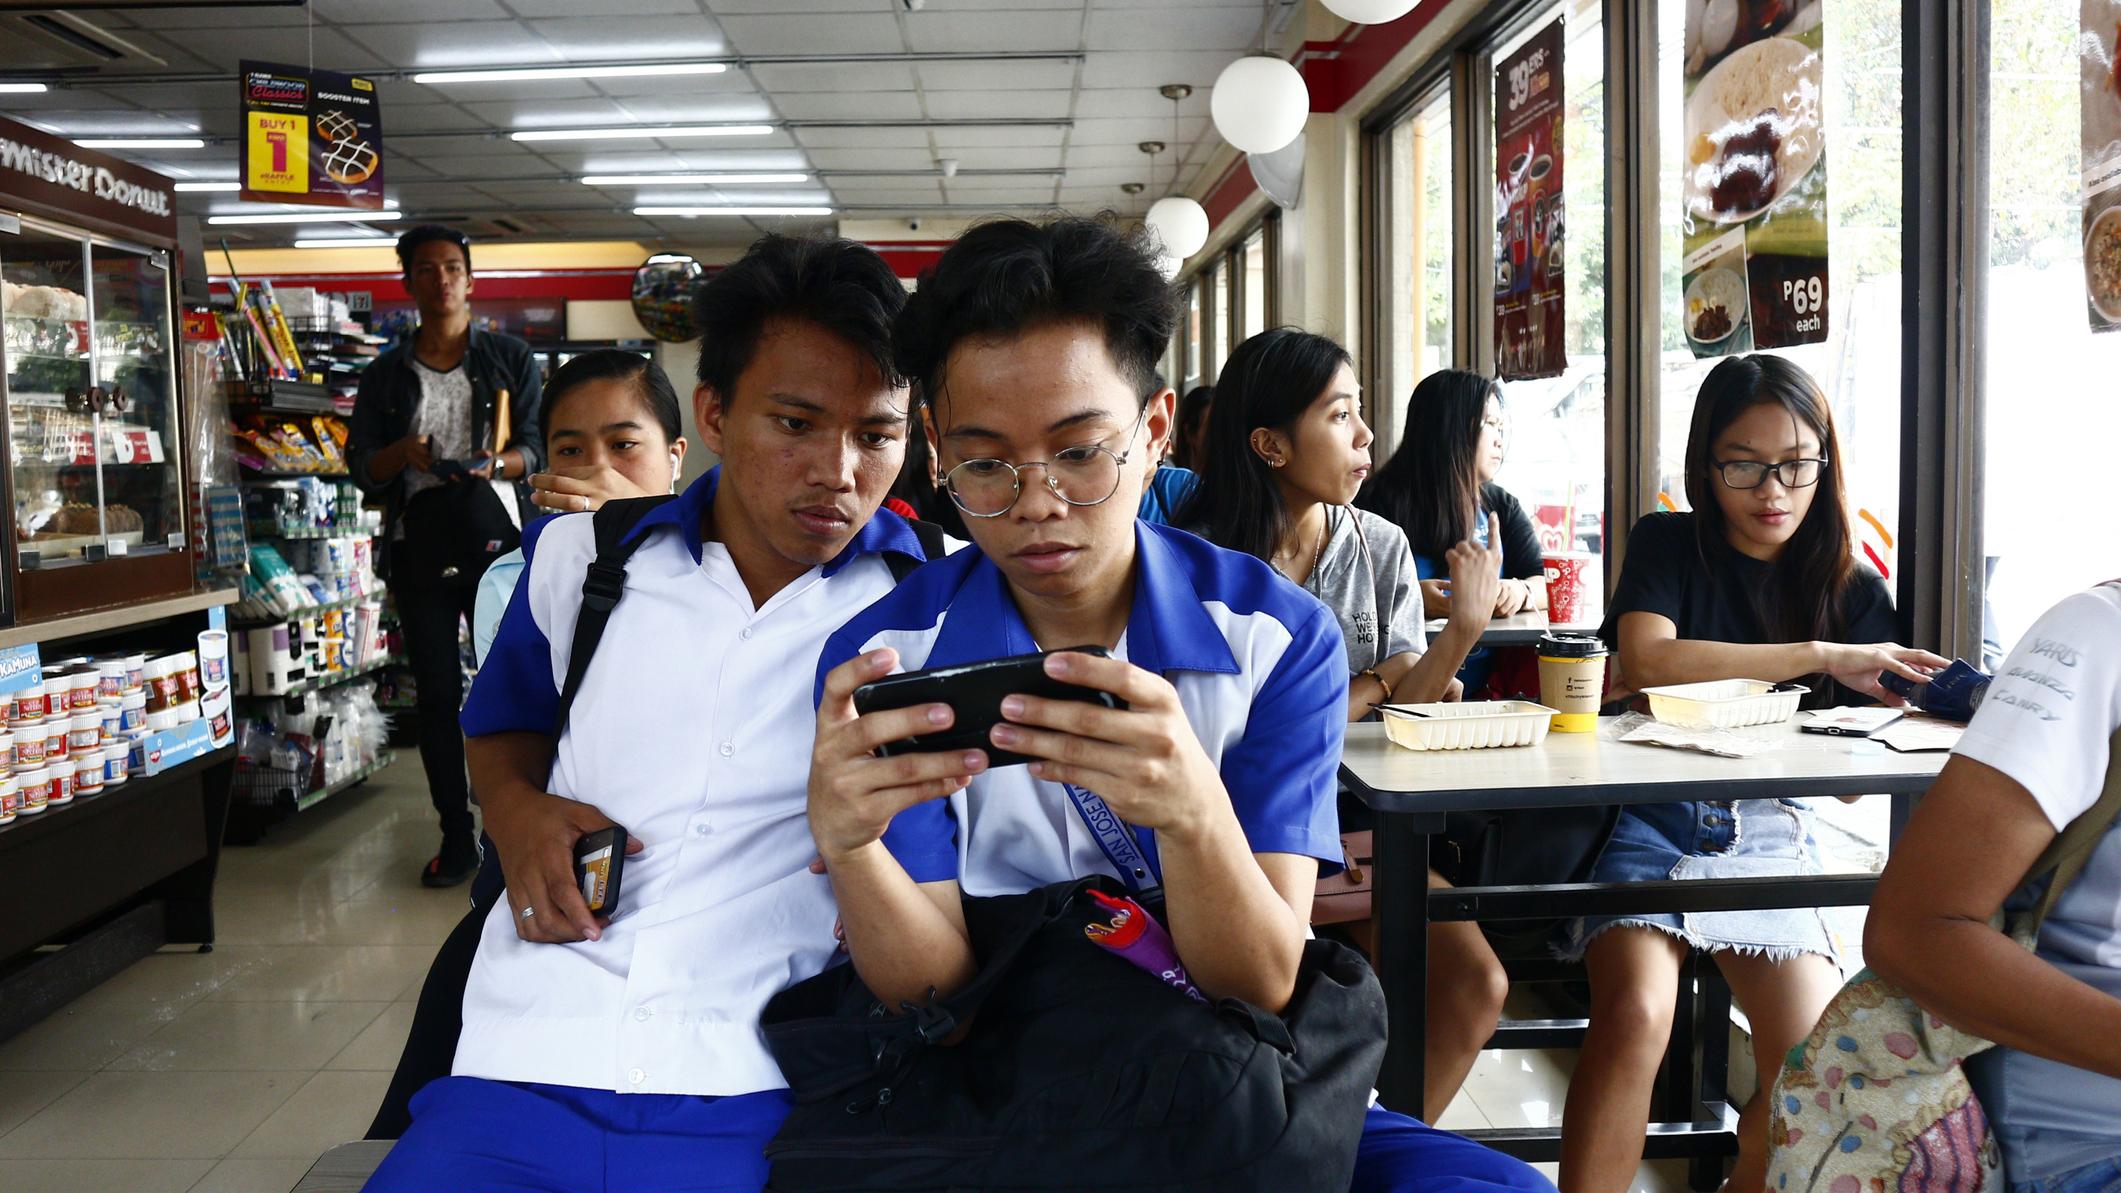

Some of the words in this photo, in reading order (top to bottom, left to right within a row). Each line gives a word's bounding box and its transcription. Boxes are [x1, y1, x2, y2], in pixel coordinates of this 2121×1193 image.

[252, 85, 304, 99] Classics
[317, 92, 352, 102] BOOSTER
[353, 96, 370, 104] ITEM
[260, 118, 287, 129] BUY
[290, 120, 296, 130] 1
[266, 131, 287, 173] 1
[0, 137, 93, 192] Mister
[95, 166, 171, 217] Donut
[1796, 314, 1821, 332] each
[1085, 802, 1118, 837] JOSE
[1107, 839, 1136, 864] SAN
